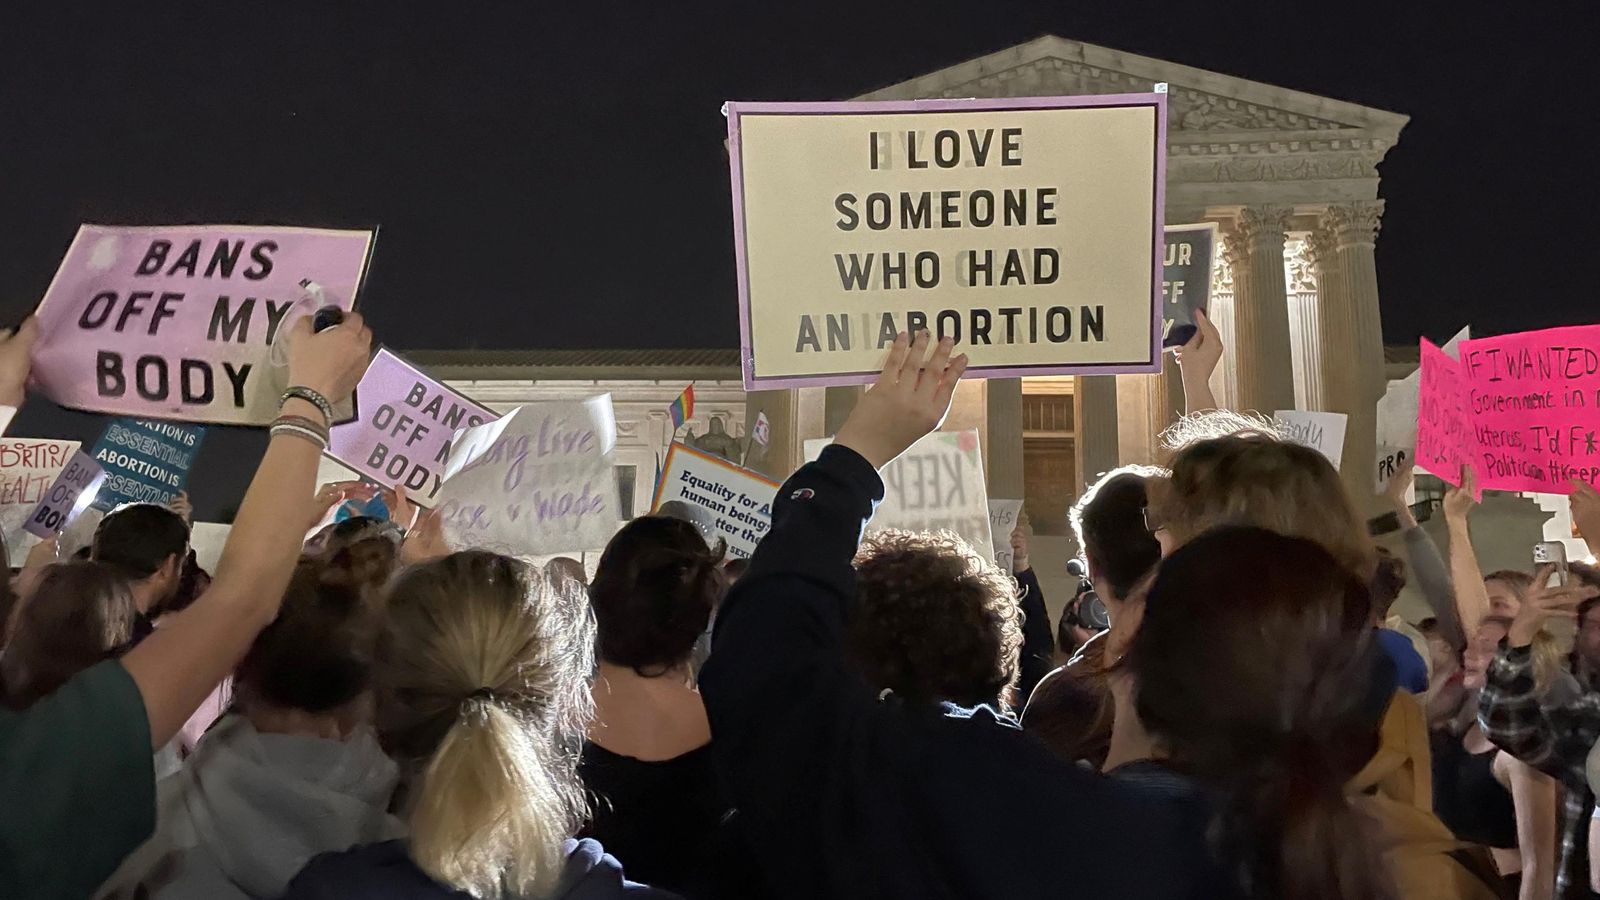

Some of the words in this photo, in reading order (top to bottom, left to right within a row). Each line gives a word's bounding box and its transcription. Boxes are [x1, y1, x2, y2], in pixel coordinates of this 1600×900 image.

[870, 131, 878, 170] I
[907, 128, 1024, 169] LOVE
[835, 187, 1058, 231] SOMEONE
[135, 239, 279, 280] BANS
[835, 251, 940, 290] WHO
[968, 248, 1060, 287] HAD
[1162, 243, 1192, 266] UR
[78, 292, 186, 335] OFF
[207, 295, 294, 346] MY
[796, 313, 851, 353] AN
[878, 304, 1105, 349] ABORTION
[96, 351, 252, 408] BODY
[1465, 350, 1481, 379] IF
[1486, 349, 1502, 382] I
[1506, 347, 1599, 381] WANTED
[1470, 388, 1556, 415] Government
[1564, 386, 1585, 408] in
[184, 432, 196, 447] IS
[372, 404, 430, 447] OFF
[1530, 426, 1562, 456] I'd
[96, 448, 168, 483] ABORTION
[168, 473, 180, 487] IS
[106, 424, 190, 470] ESSENTIAL
[102, 471, 176, 505] SSENTIA
[367, 442, 443, 499] BODY
[680, 470, 736, 502] Equality
[737, 493, 758, 510] for
[757, 503, 772, 518] A
[680, 486, 726, 515] human
[715, 518, 739, 535] tter
